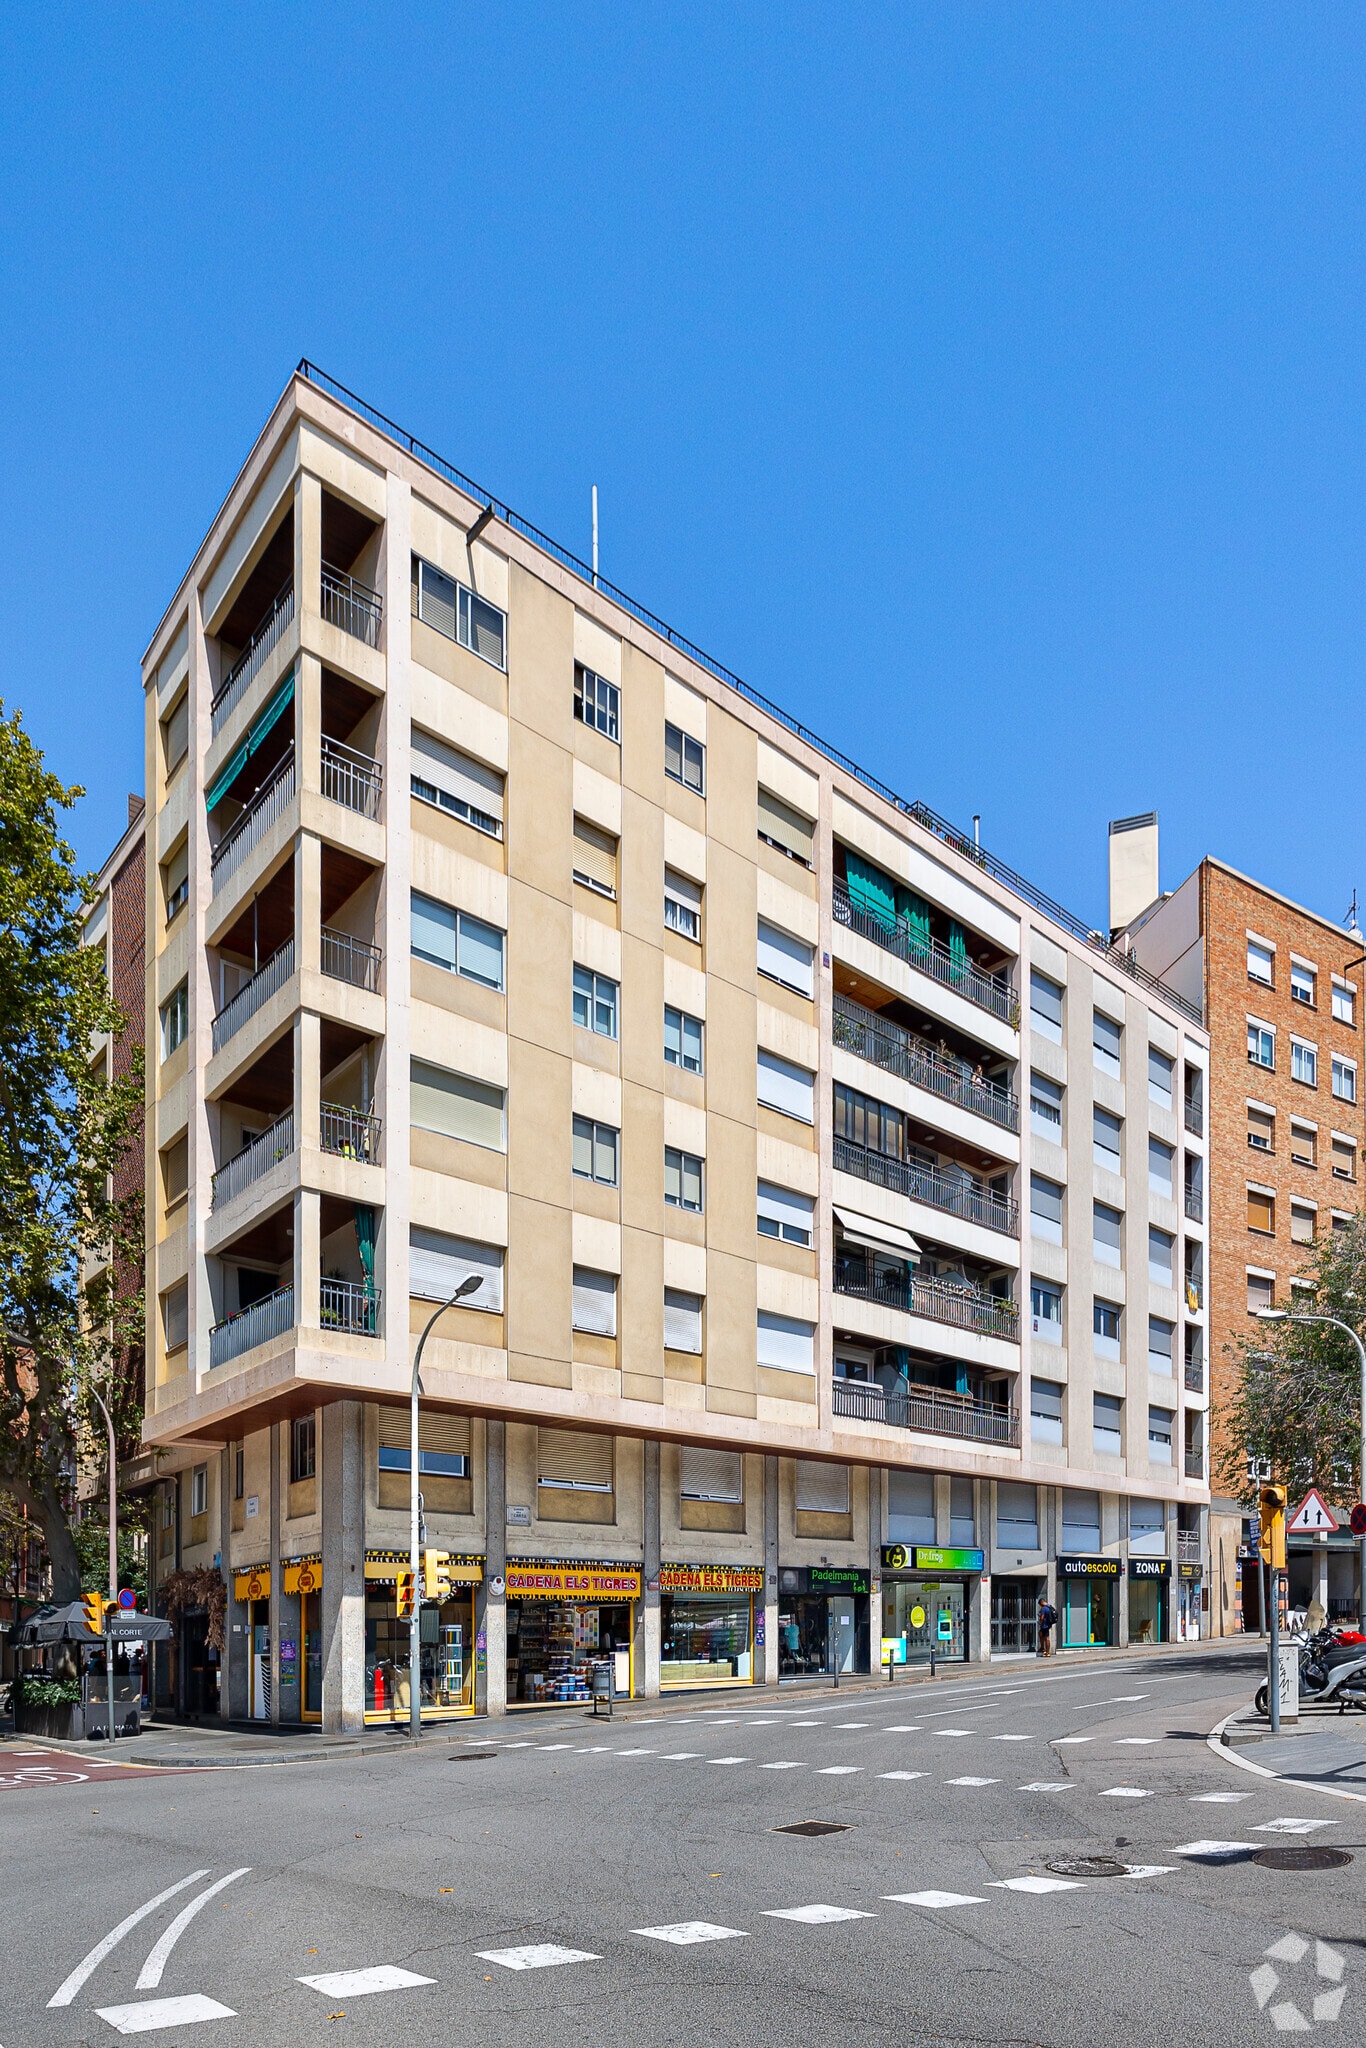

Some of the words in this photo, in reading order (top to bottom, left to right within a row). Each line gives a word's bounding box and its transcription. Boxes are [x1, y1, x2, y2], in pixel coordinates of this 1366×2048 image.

[1065, 1561, 1117, 1573] autoescola
[660, 1572, 700, 1585] CADENA
[704, 1573, 723, 1586] ELS
[725, 1574, 761, 1587] TIGRES
[812, 1569, 859, 1580] Padelmania
[507, 1574, 561, 1588] CADENA
[565, 1576, 589, 1589] ELS
[592, 1577, 637, 1590] TIGRES
